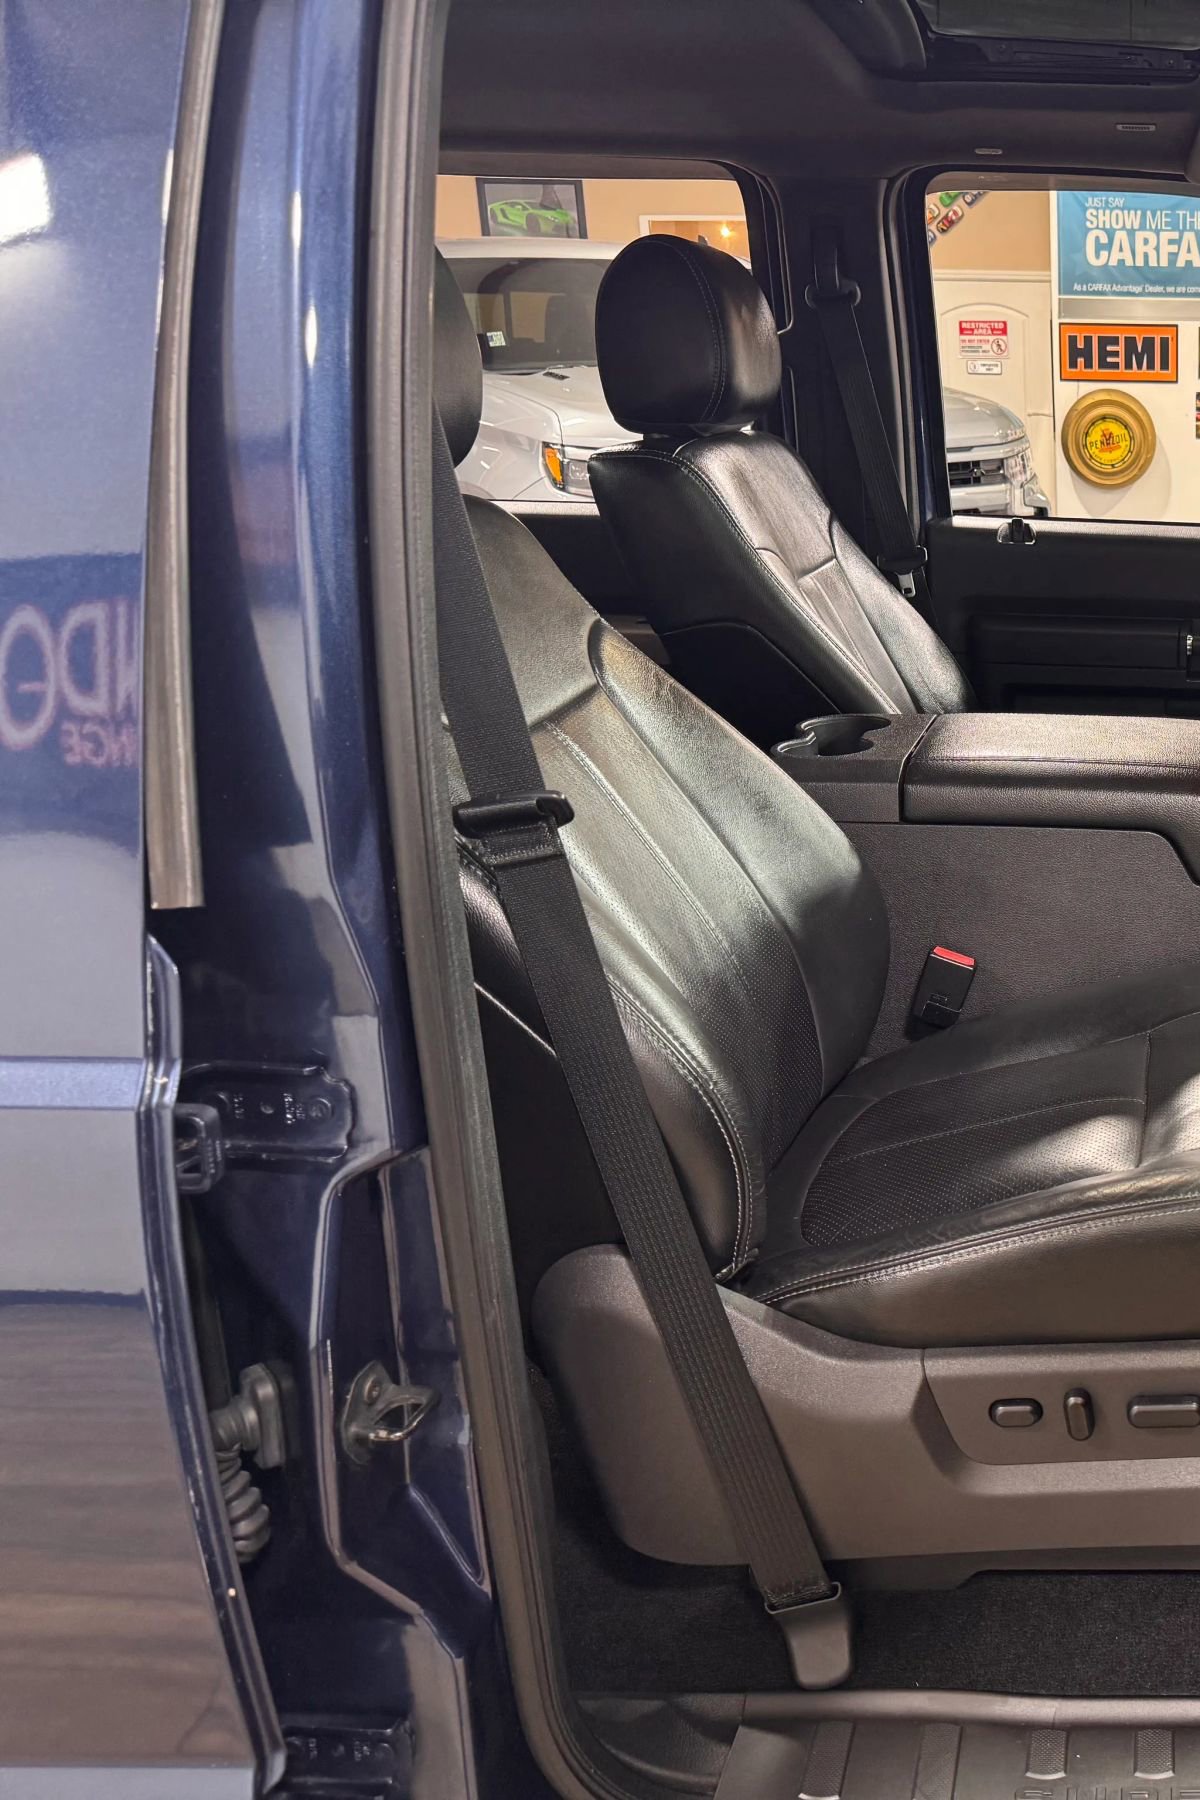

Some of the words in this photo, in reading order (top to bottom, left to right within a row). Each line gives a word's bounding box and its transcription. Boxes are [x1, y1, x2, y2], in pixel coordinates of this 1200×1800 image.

[1085, 197, 1106, 208] JUST
[1108, 197, 1125, 208] SAY
[1085, 208, 1142, 230] SHOW
[1146, 210, 1172, 230] ME
[1166, 286, 1175, 294] we
[1176, 286, 1186, 294] are
[1067, 333, 1171, 372] HEMI
